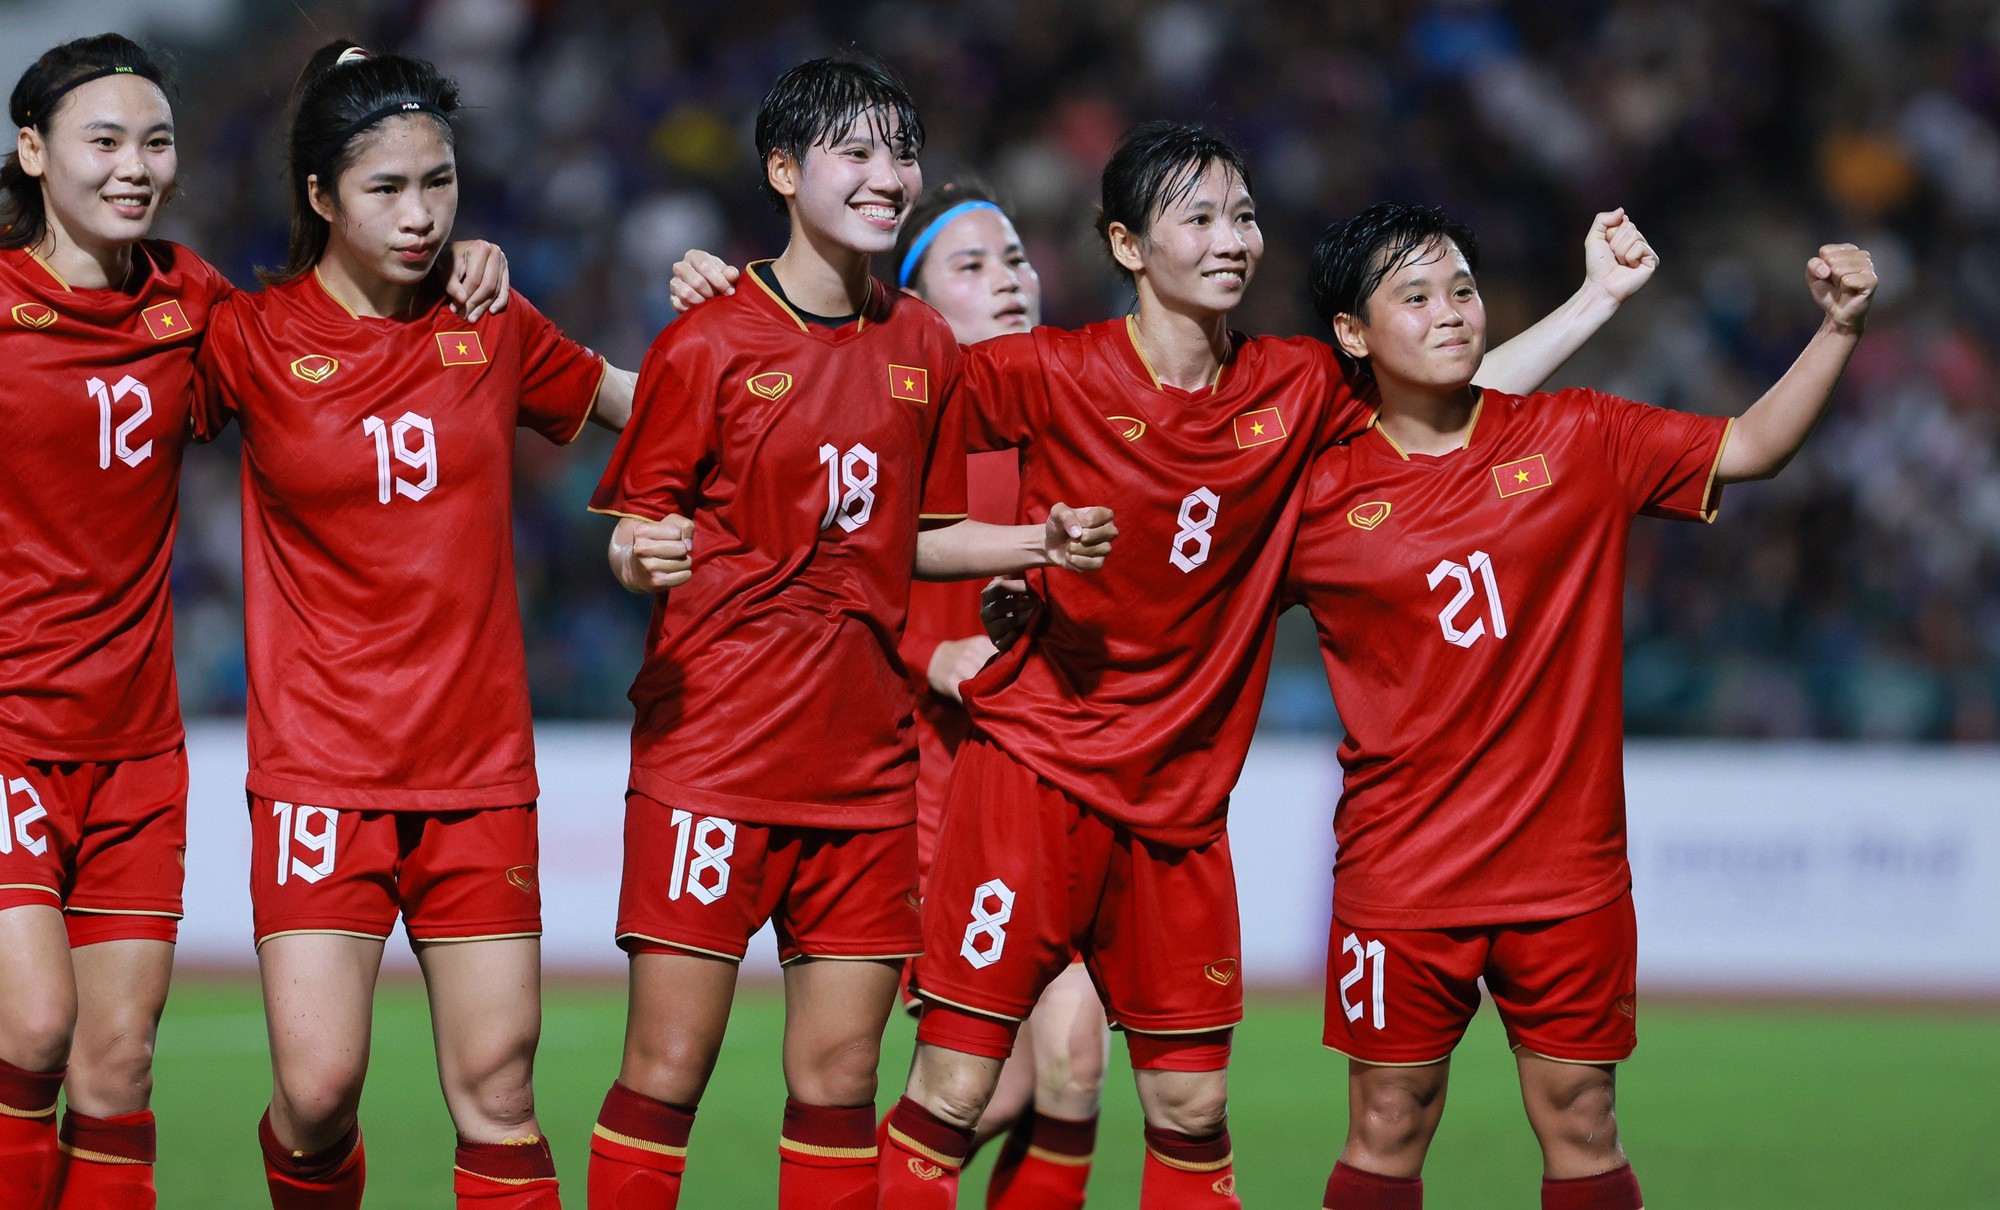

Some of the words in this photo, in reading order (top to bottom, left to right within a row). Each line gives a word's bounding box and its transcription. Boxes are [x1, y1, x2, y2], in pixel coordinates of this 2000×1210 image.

[402, 101, 420, 110] FILA
[86, 374, 153, 470] 12
[362, 410, 438, 505] 19
[819, 442, 878, 534] 18
[1168, 486, 1221, 574] 8
[1425, 550, 1508, 649] 21
[0, 773, 48, 857] 12
[272, 800, 339, 886] 19
[668, 808, 737, 906] 18
[959, 877, 1016, 970] 8
[1340, 932, 1386, 1031] 21
